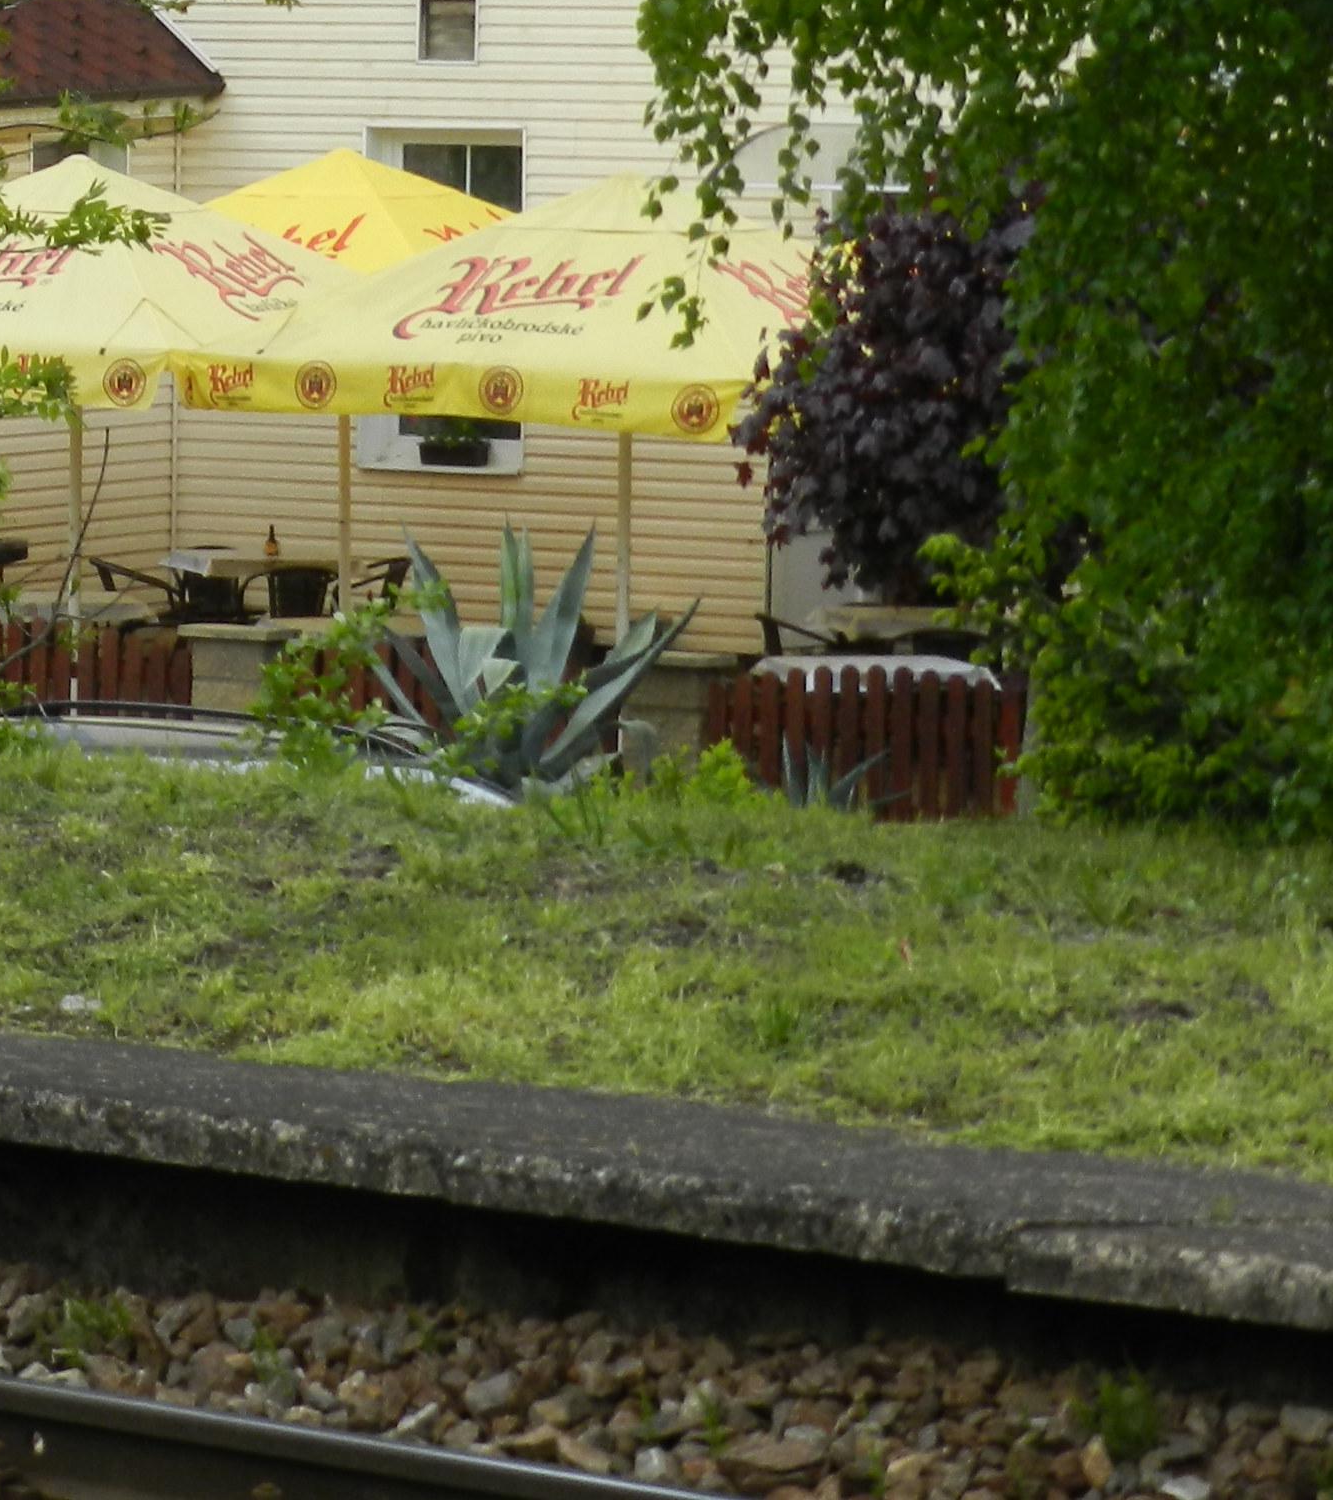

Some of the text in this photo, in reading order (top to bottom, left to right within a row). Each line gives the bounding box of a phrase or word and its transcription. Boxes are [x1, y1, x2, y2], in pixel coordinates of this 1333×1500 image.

[393, 253, 646, 340] Rebel
[455, 331, 503, 345] pivo
[208, 362, 253, 406] Rebel
[383, 362, 436, 407] Rebel
[571, 378, 629, 421] Rebel
